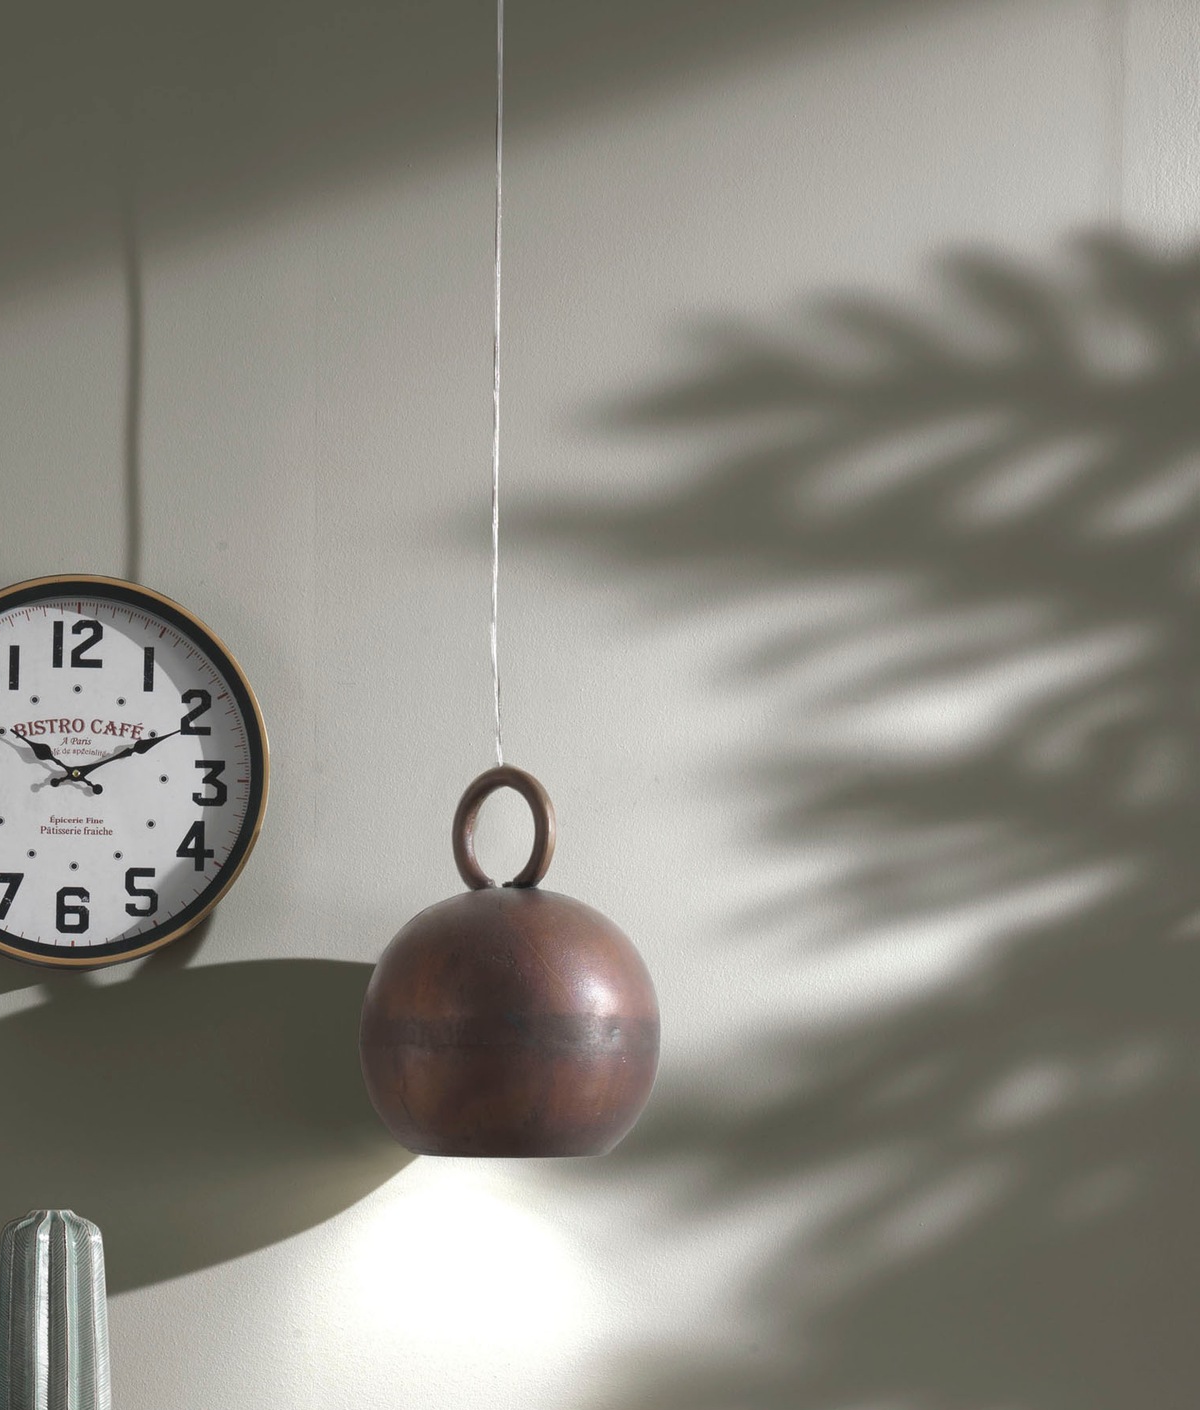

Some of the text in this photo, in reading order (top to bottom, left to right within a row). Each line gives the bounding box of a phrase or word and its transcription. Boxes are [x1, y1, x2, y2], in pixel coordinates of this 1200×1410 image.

[52, 620, 103, 668] 12
[143, 647, 155, 692] 1
[13, 718, 144, 740] BISTRO CAFÉ
[180, 689, 212, 735] 2
[71, 736, 92, 746] Paris
[191, 760, 228, 807] 3
[40, 825, 82, 835] Pâtisserie
[49, 815, 104, 826] Épicerie Fine
[176, 821, 214, 871] 4
[55, 886, 90, 934] 6
[125, 867, 158, 917] 5
